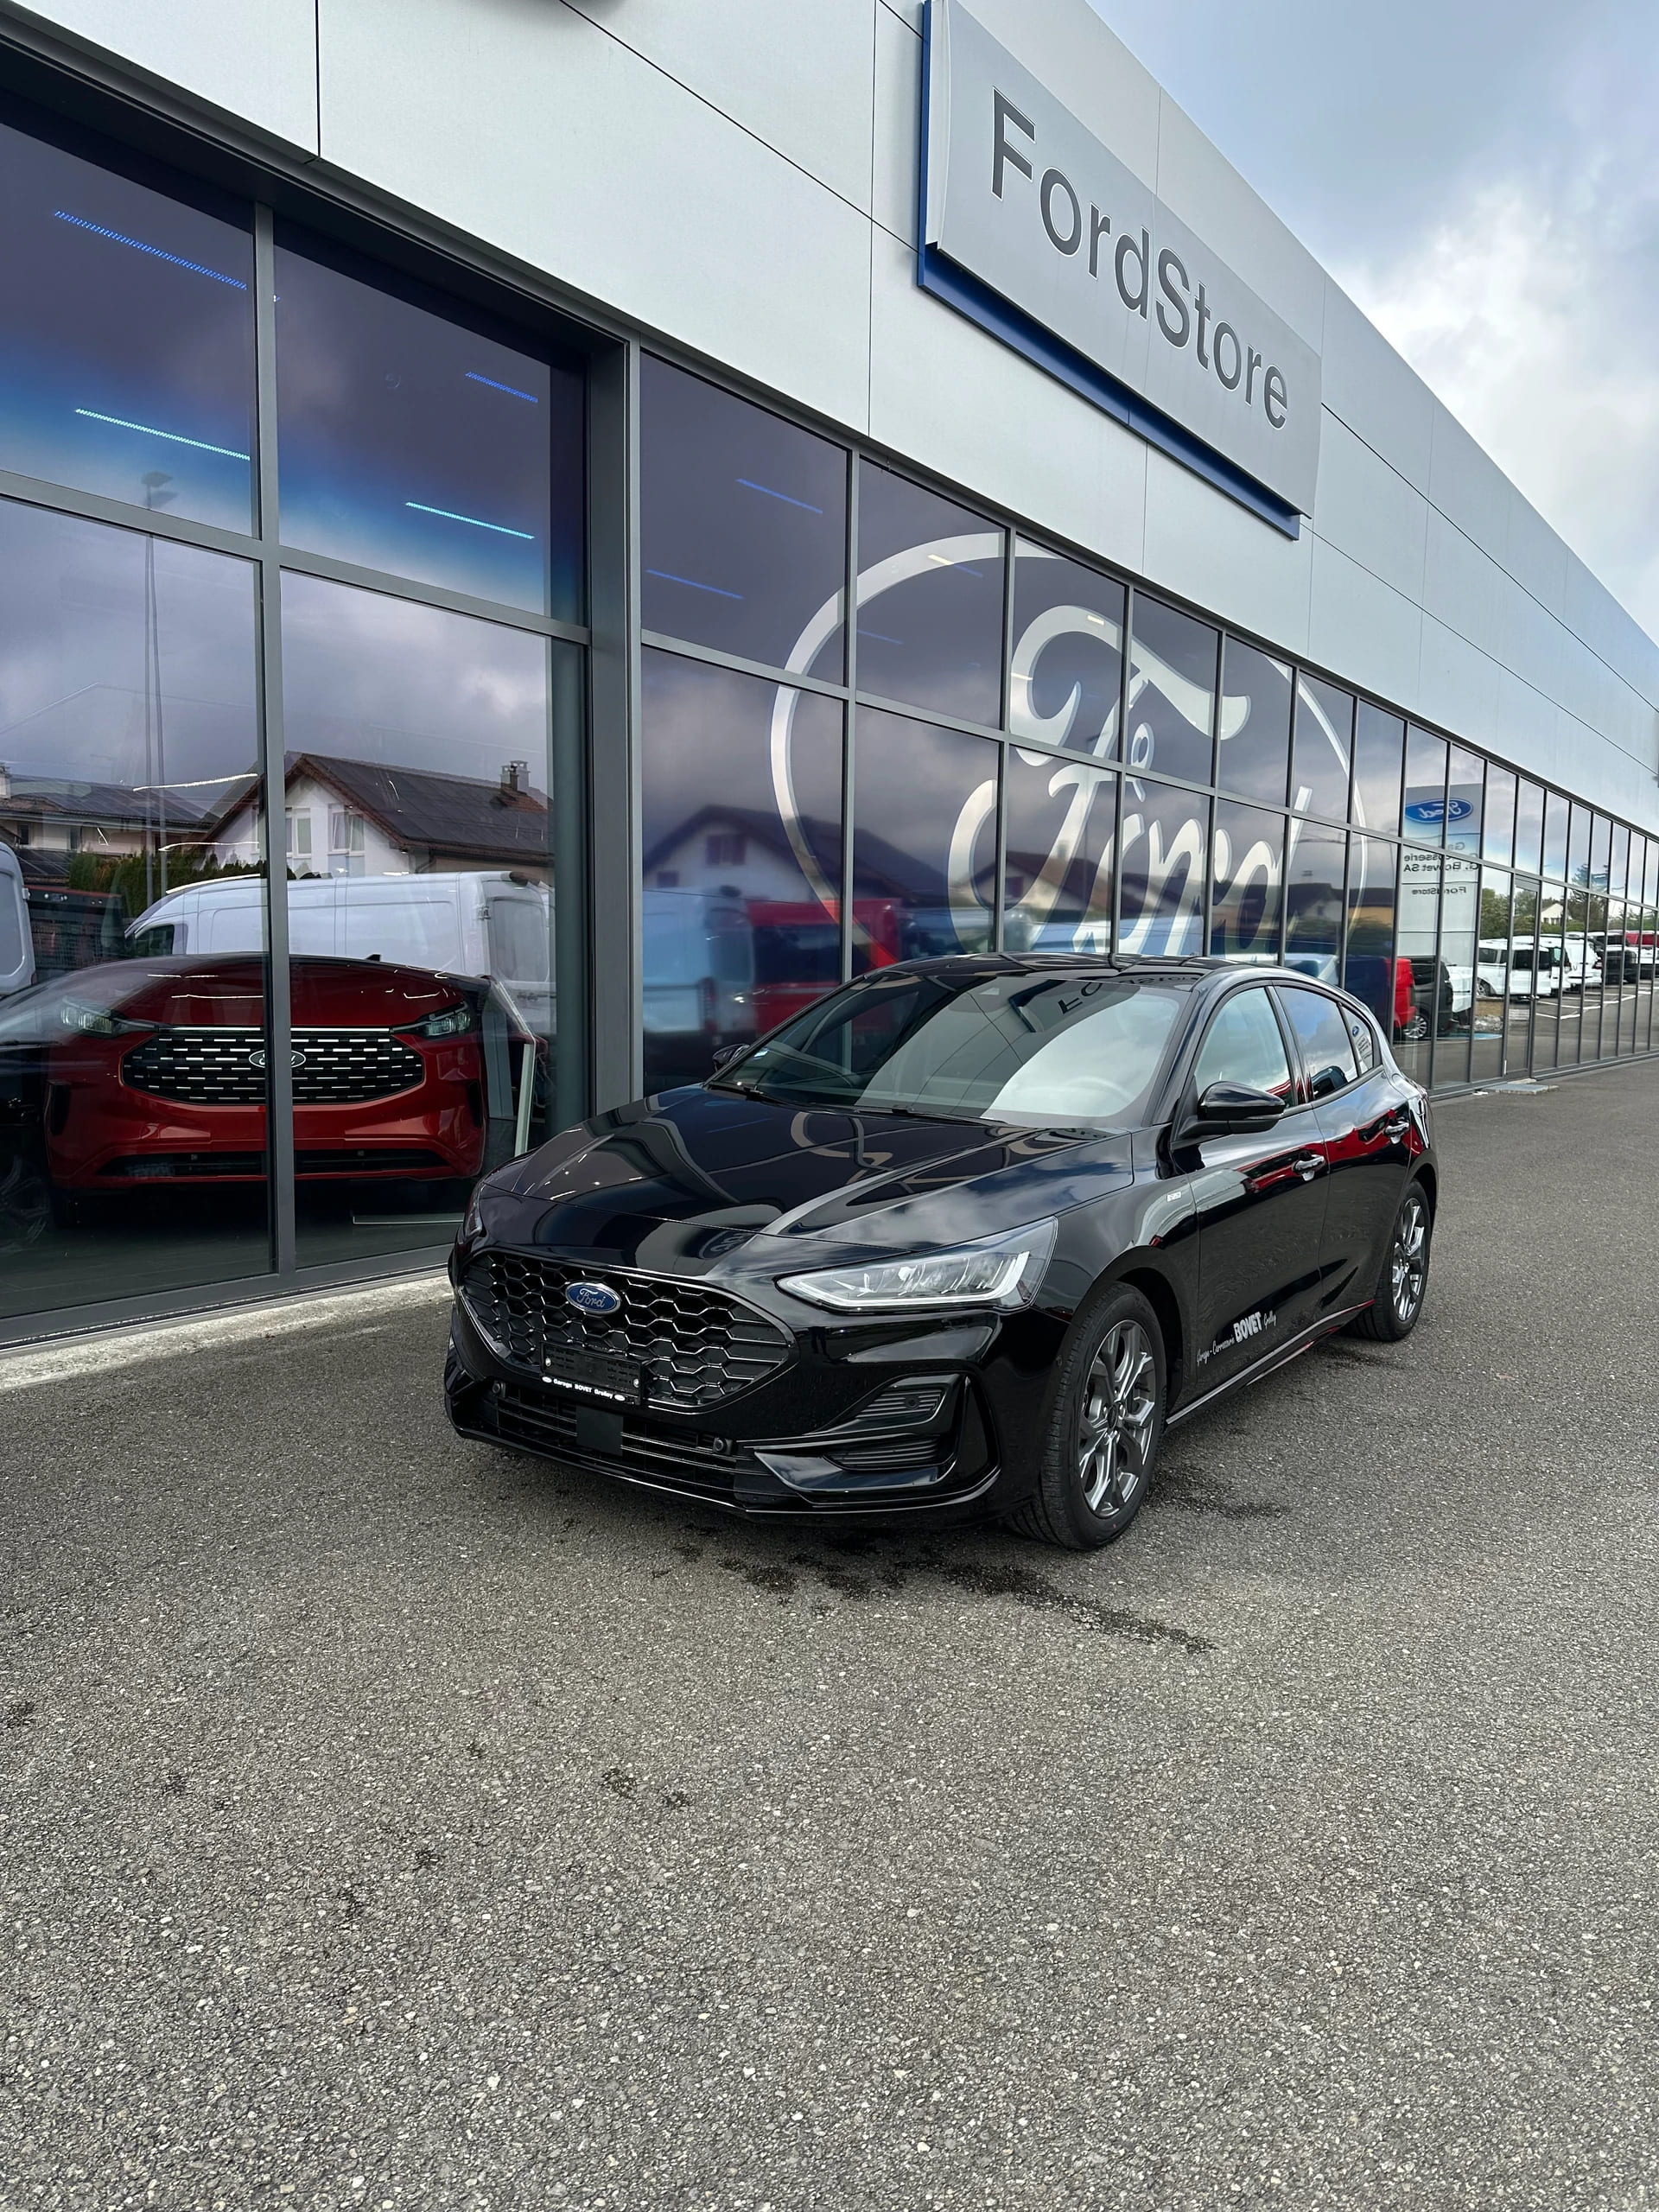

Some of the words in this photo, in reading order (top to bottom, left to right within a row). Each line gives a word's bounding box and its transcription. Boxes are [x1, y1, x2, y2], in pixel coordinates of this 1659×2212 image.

[992, 86, 1288, 430] FordStore
[948, 605, 1313, 957] Ford
[576, 1288, 606, 1307] Ford
[1233, 1311, 1262, 1344] BOVET
[574, 1383, 593, 1393] BOVET
